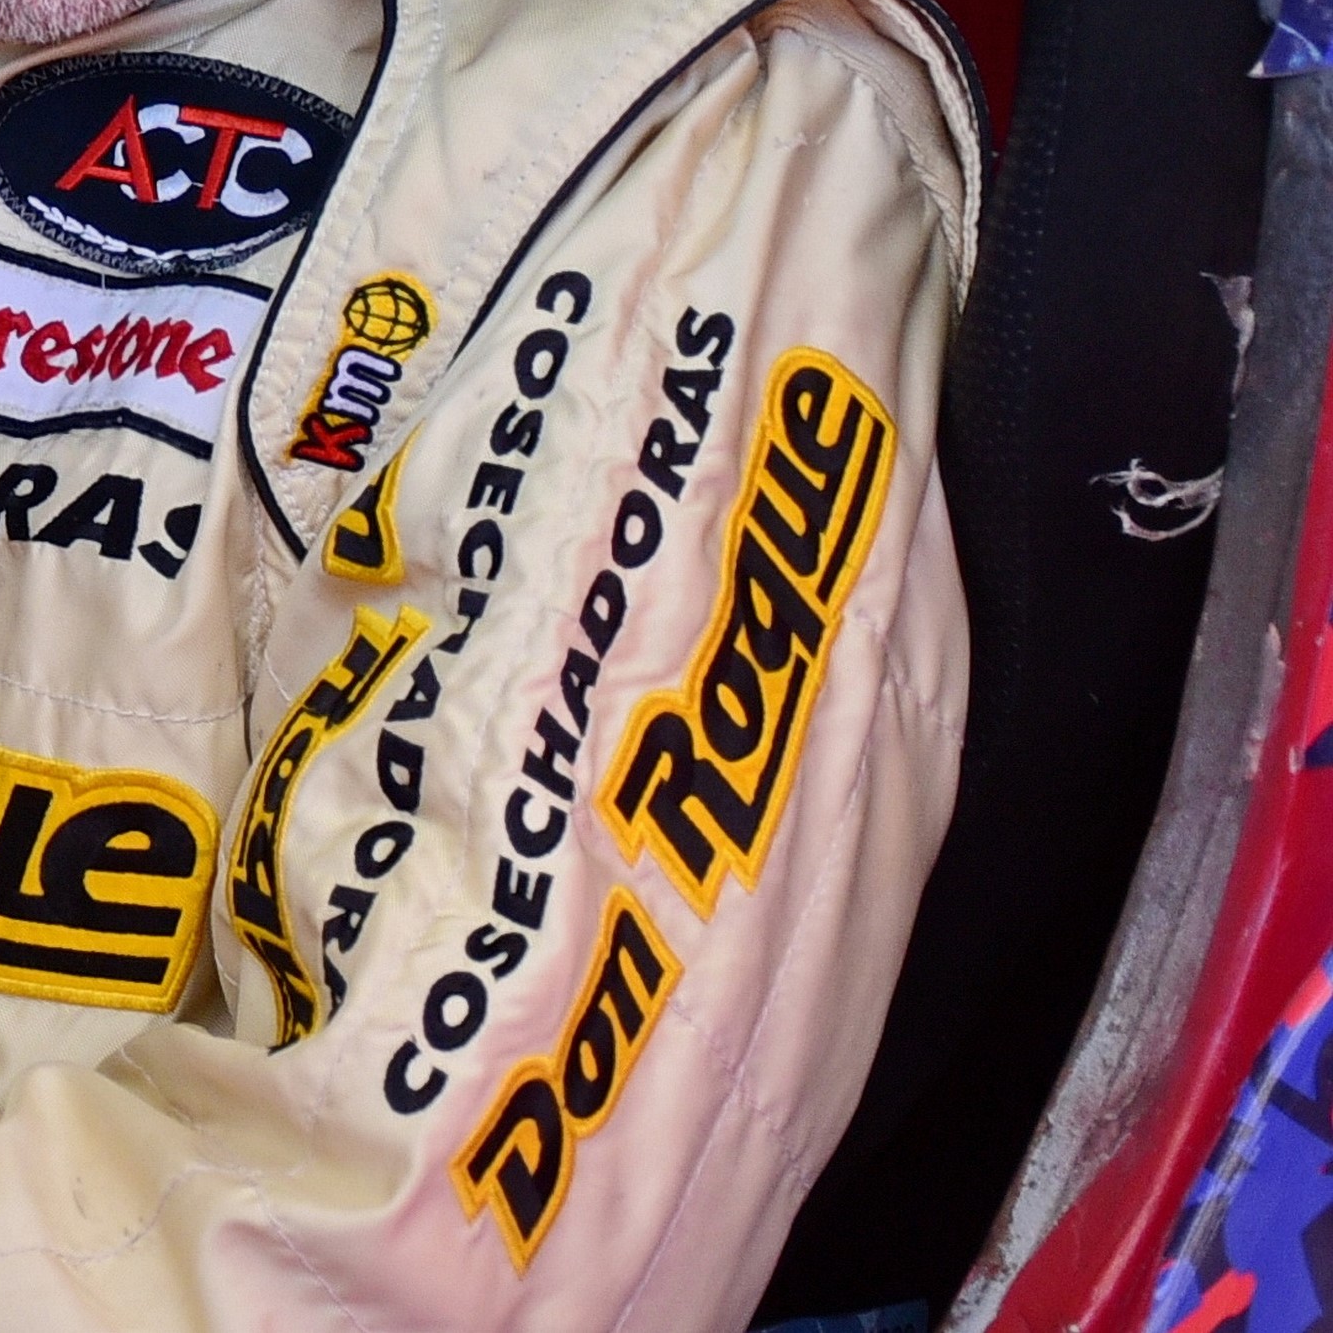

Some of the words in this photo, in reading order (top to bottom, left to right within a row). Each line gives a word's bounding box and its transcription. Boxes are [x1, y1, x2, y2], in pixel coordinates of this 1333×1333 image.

[55, 94, 313, 218] ACTC
[322, 270, 593, 1023] COSECHADORA
[382, 306, 734, 1115] COSECHADORAS
[464, 907, 667, 1241] Don
[614, 364, 887, 884] Roque
